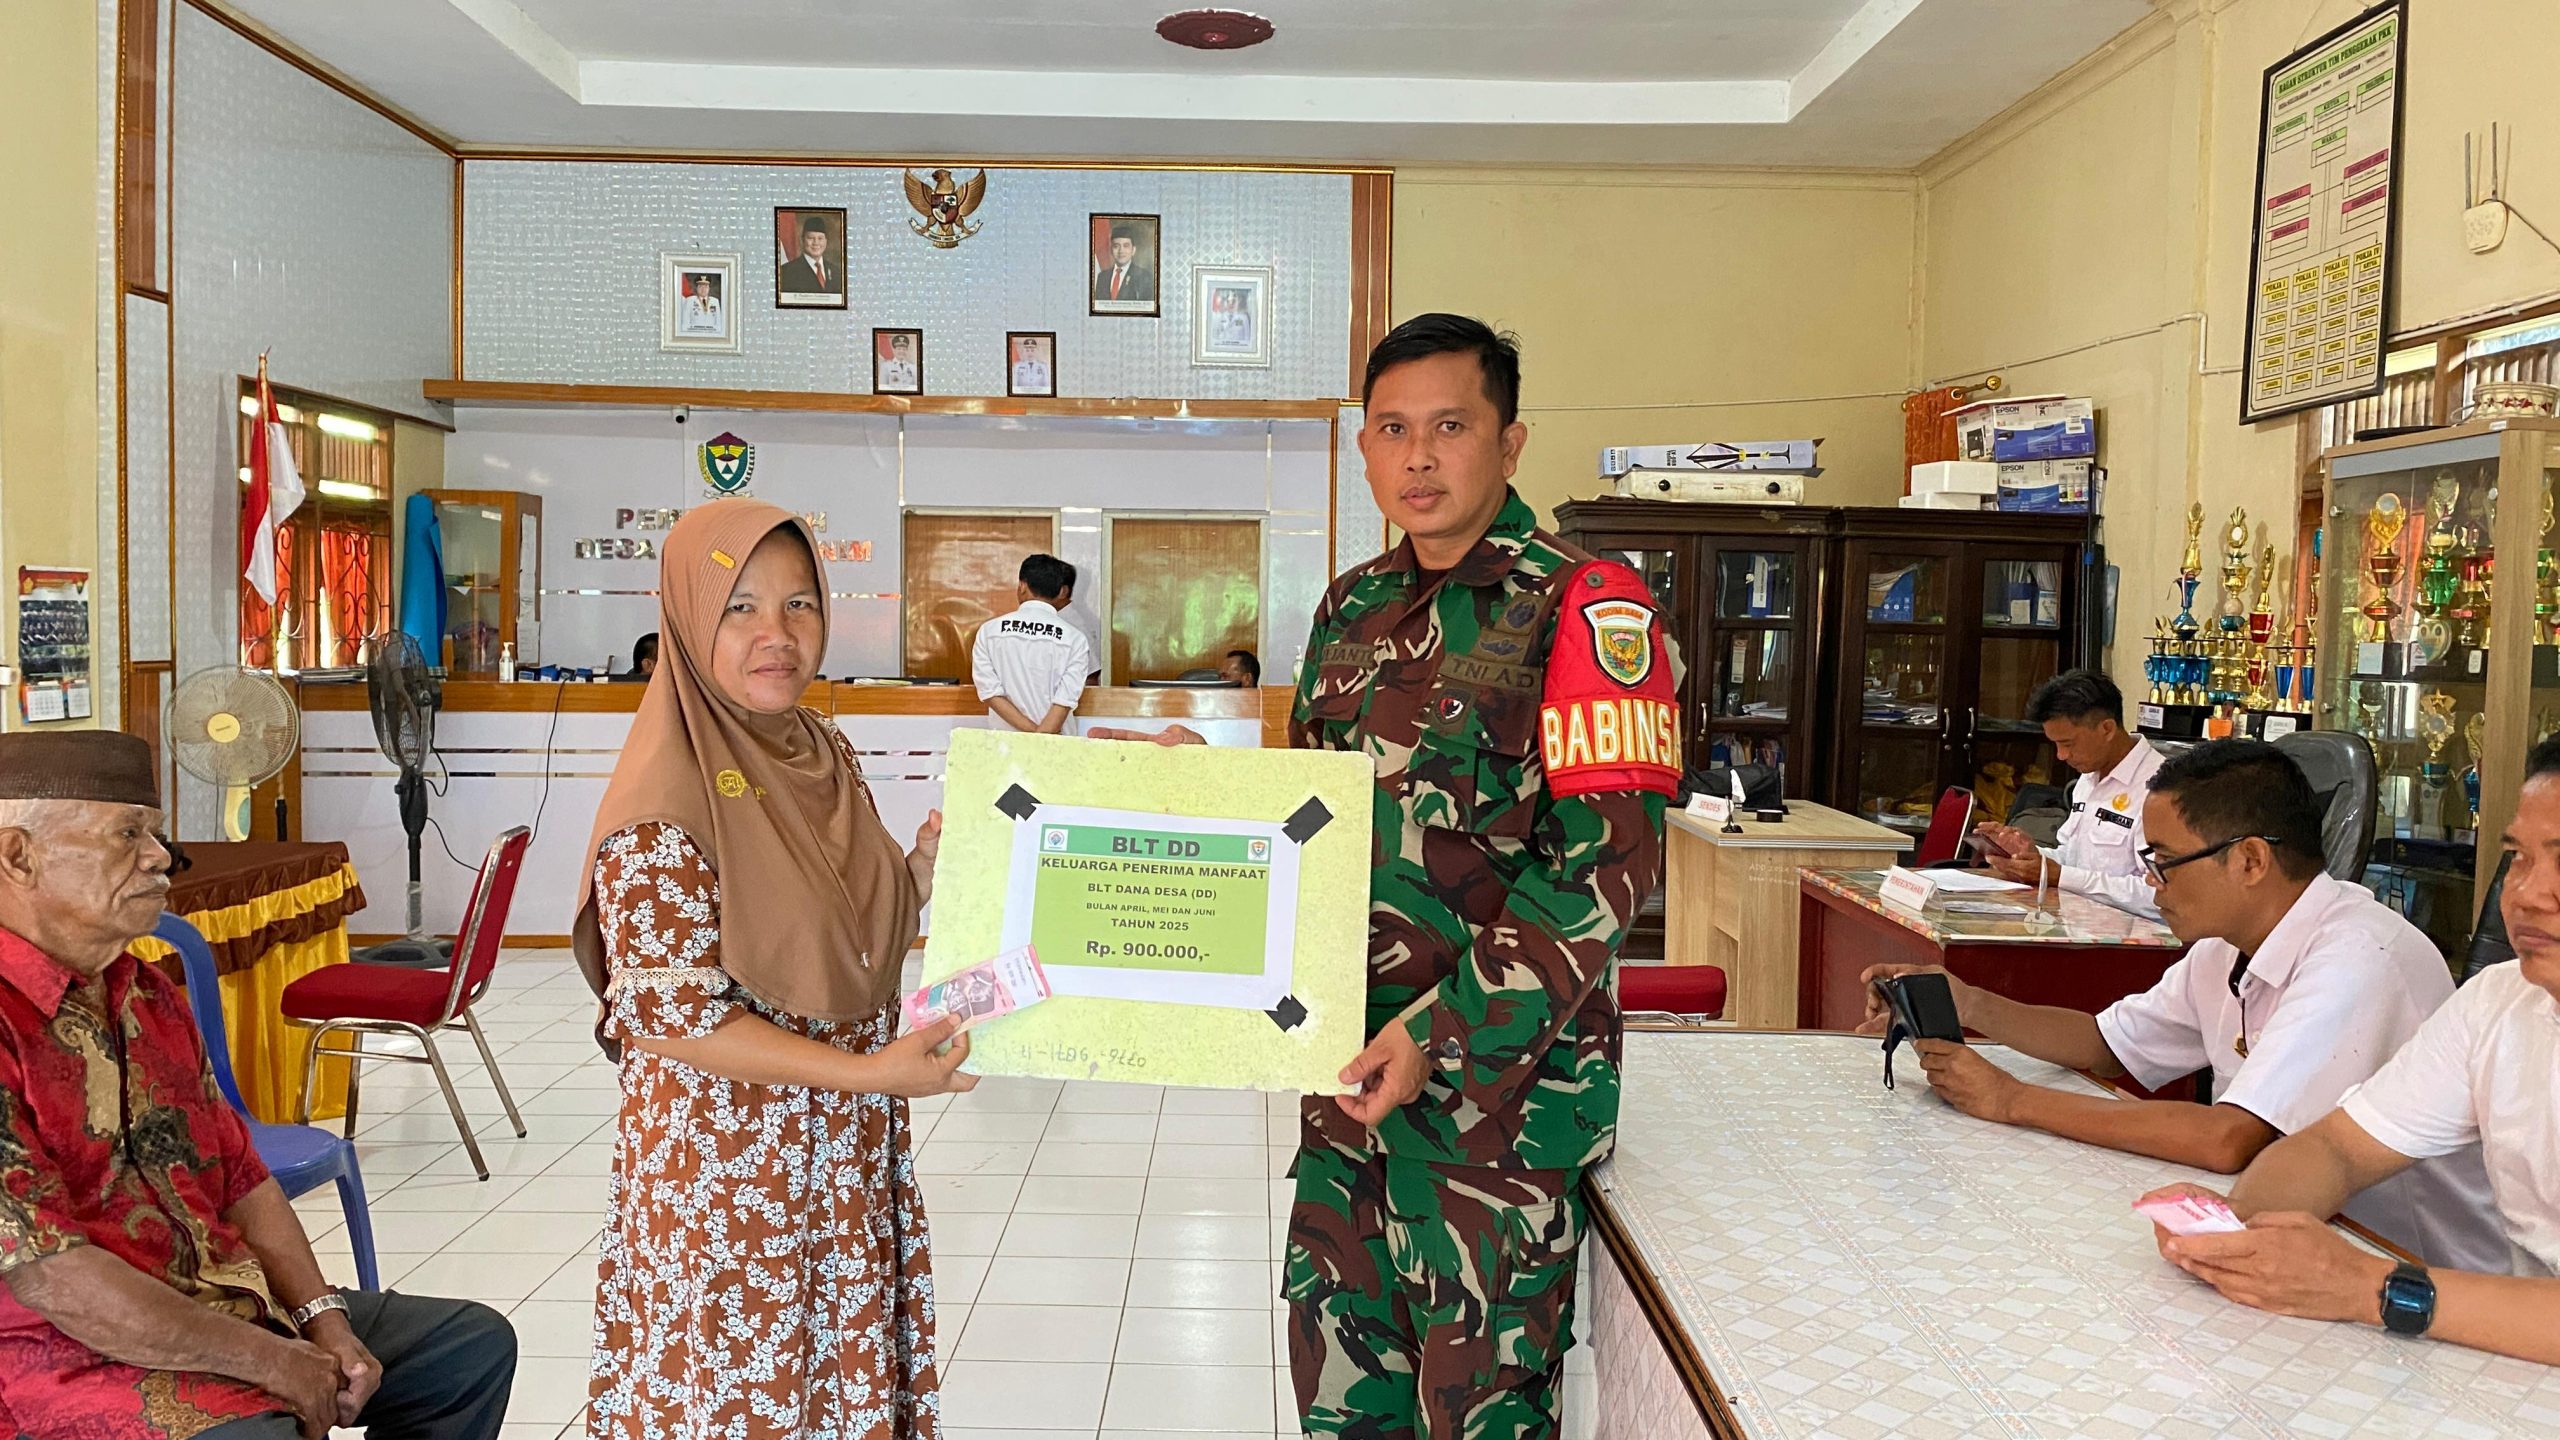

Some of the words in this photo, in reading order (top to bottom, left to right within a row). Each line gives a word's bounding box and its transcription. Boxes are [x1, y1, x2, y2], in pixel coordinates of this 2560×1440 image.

[1995, 405, 2020, 415] EPSON
[2001, 464, 2025, 473] EPSON
[575, 538, 656, 560] DESA
[1453, 658, 1489, 680] TNI
[1111, 835, 1160, 855] BLT
[1167, 839, 1201, 857] DD
[1041, 857, 1118, 872] KELUARGA
[1122, 862, 1194, 876] PENERIMA
[1199, 867, 1266, 879] MANFAAT
[1087, 882, 1112, 893] BLT
[1115, 884, 1150, 895] DANA
[1154, 887, 1188, 897] DESA
[1191, 889, 1217, 901] (DD)
[1086, 902, 1118, 911] BULAN
[1120, 904, 1150, 914] APRIL,
[1152, 906, 1169, 914] MEI
[1172, 907, 1191, 915] DAN
[1111, 918, 1155, 929] TAHUN
[1159, 921, 1189, 931] 2025
[1086, 940, 1116, 957] Rp.
[1123, 942, 1210, 962] 900.000,-
